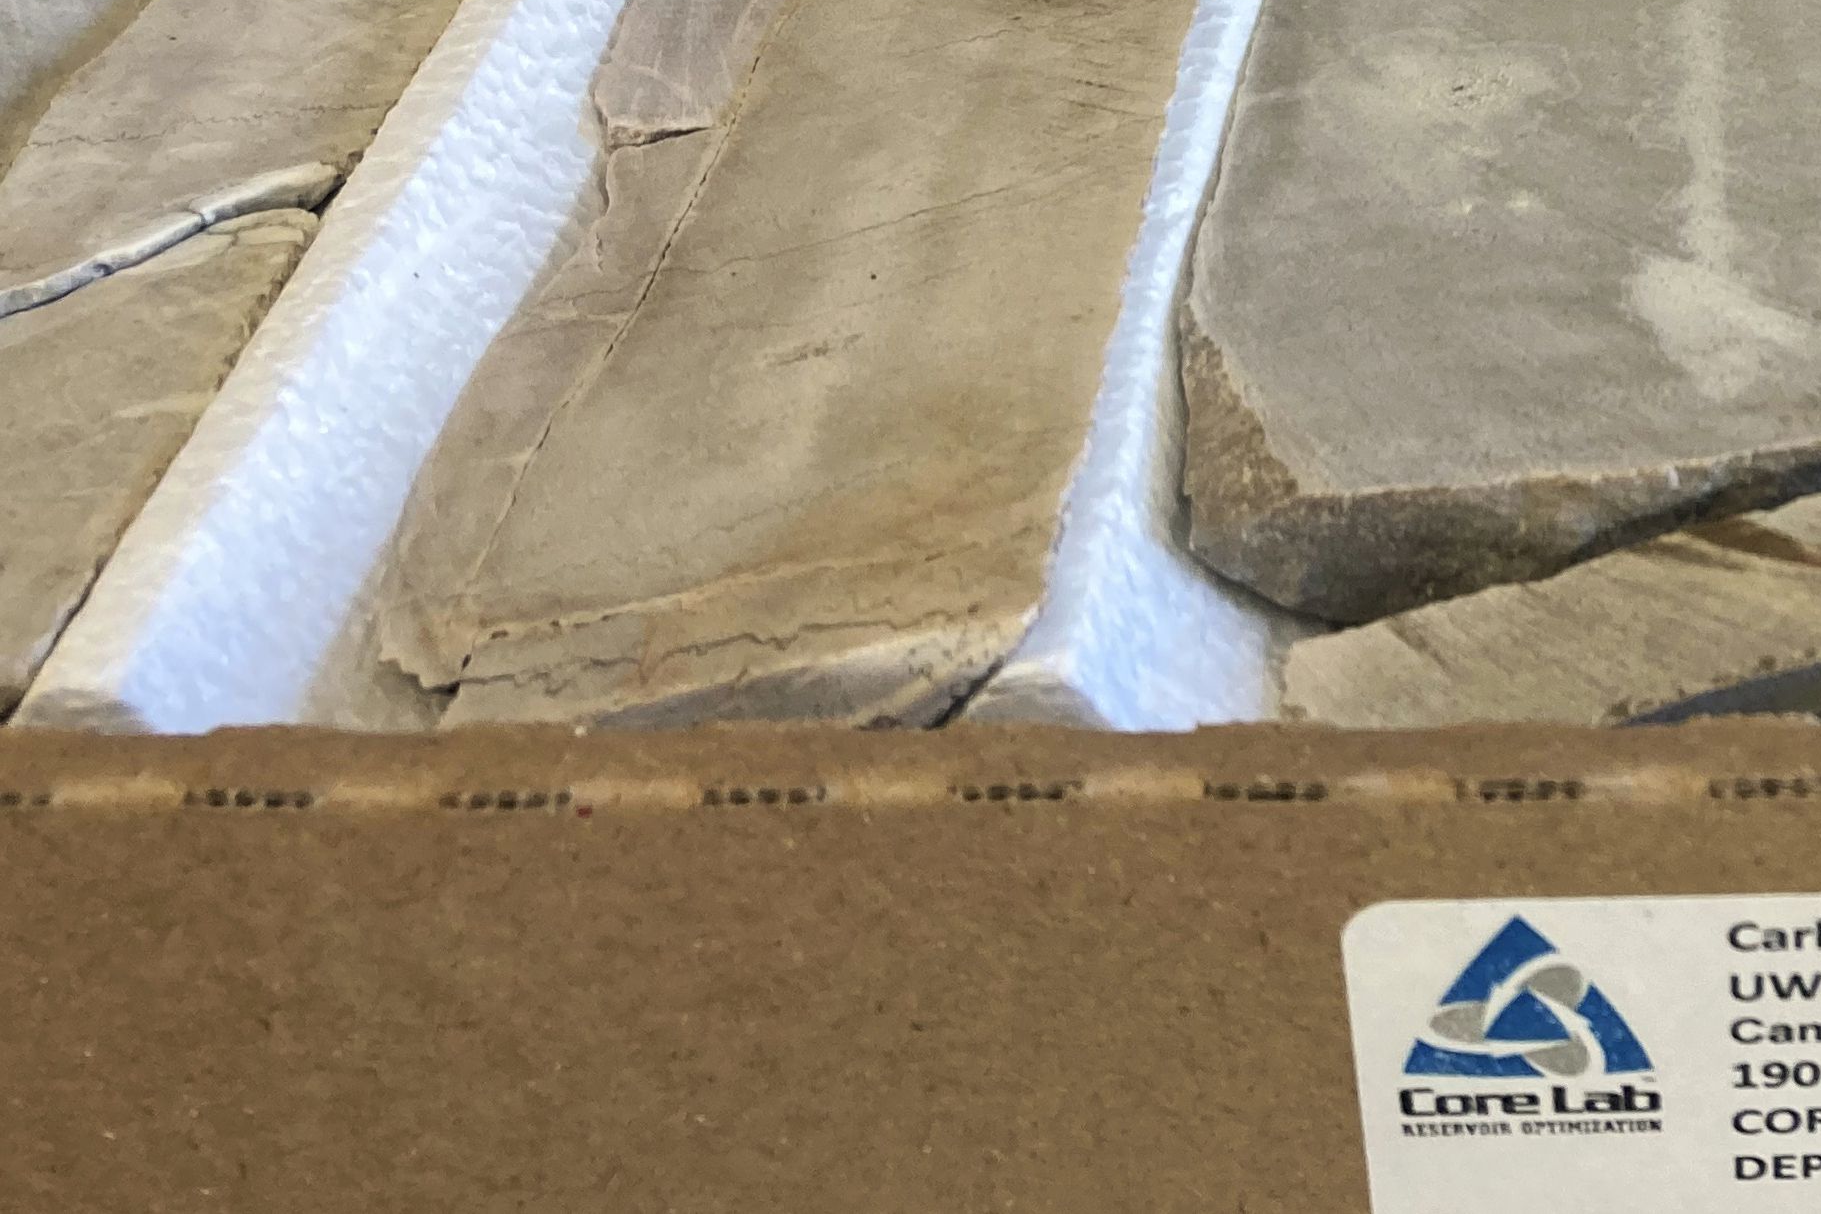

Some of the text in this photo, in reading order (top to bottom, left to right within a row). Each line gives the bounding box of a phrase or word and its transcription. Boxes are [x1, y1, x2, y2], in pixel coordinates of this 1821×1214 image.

[1399, 1085, 1663, 1117] Core Lab
[1402, 1119, 1663, 1137] RESERVOIR OPTIMIZATION
